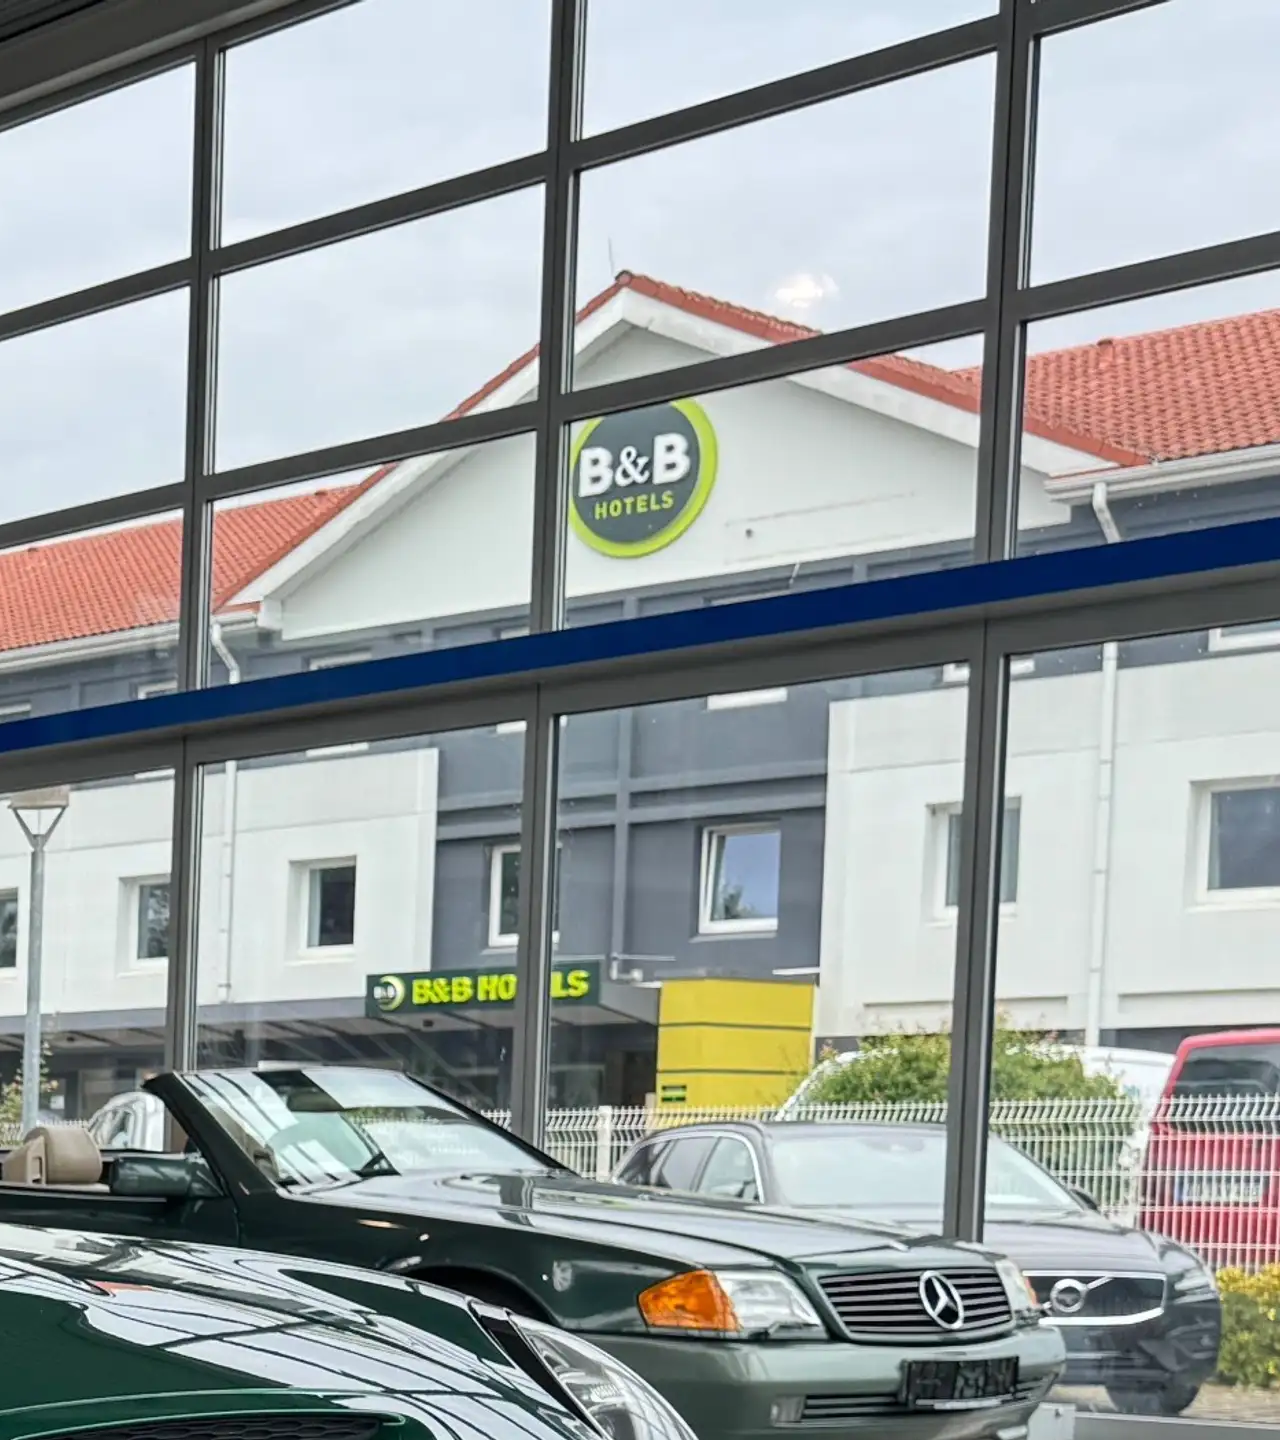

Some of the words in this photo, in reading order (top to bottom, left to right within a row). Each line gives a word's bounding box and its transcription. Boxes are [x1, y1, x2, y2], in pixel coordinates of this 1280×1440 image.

[578, 432, 691, 497] B&B
[594, 490, 674, 520] HOTELS
[411, 976, 473, 1005] B&B
[477, 969, 590, 1001] HOLS
